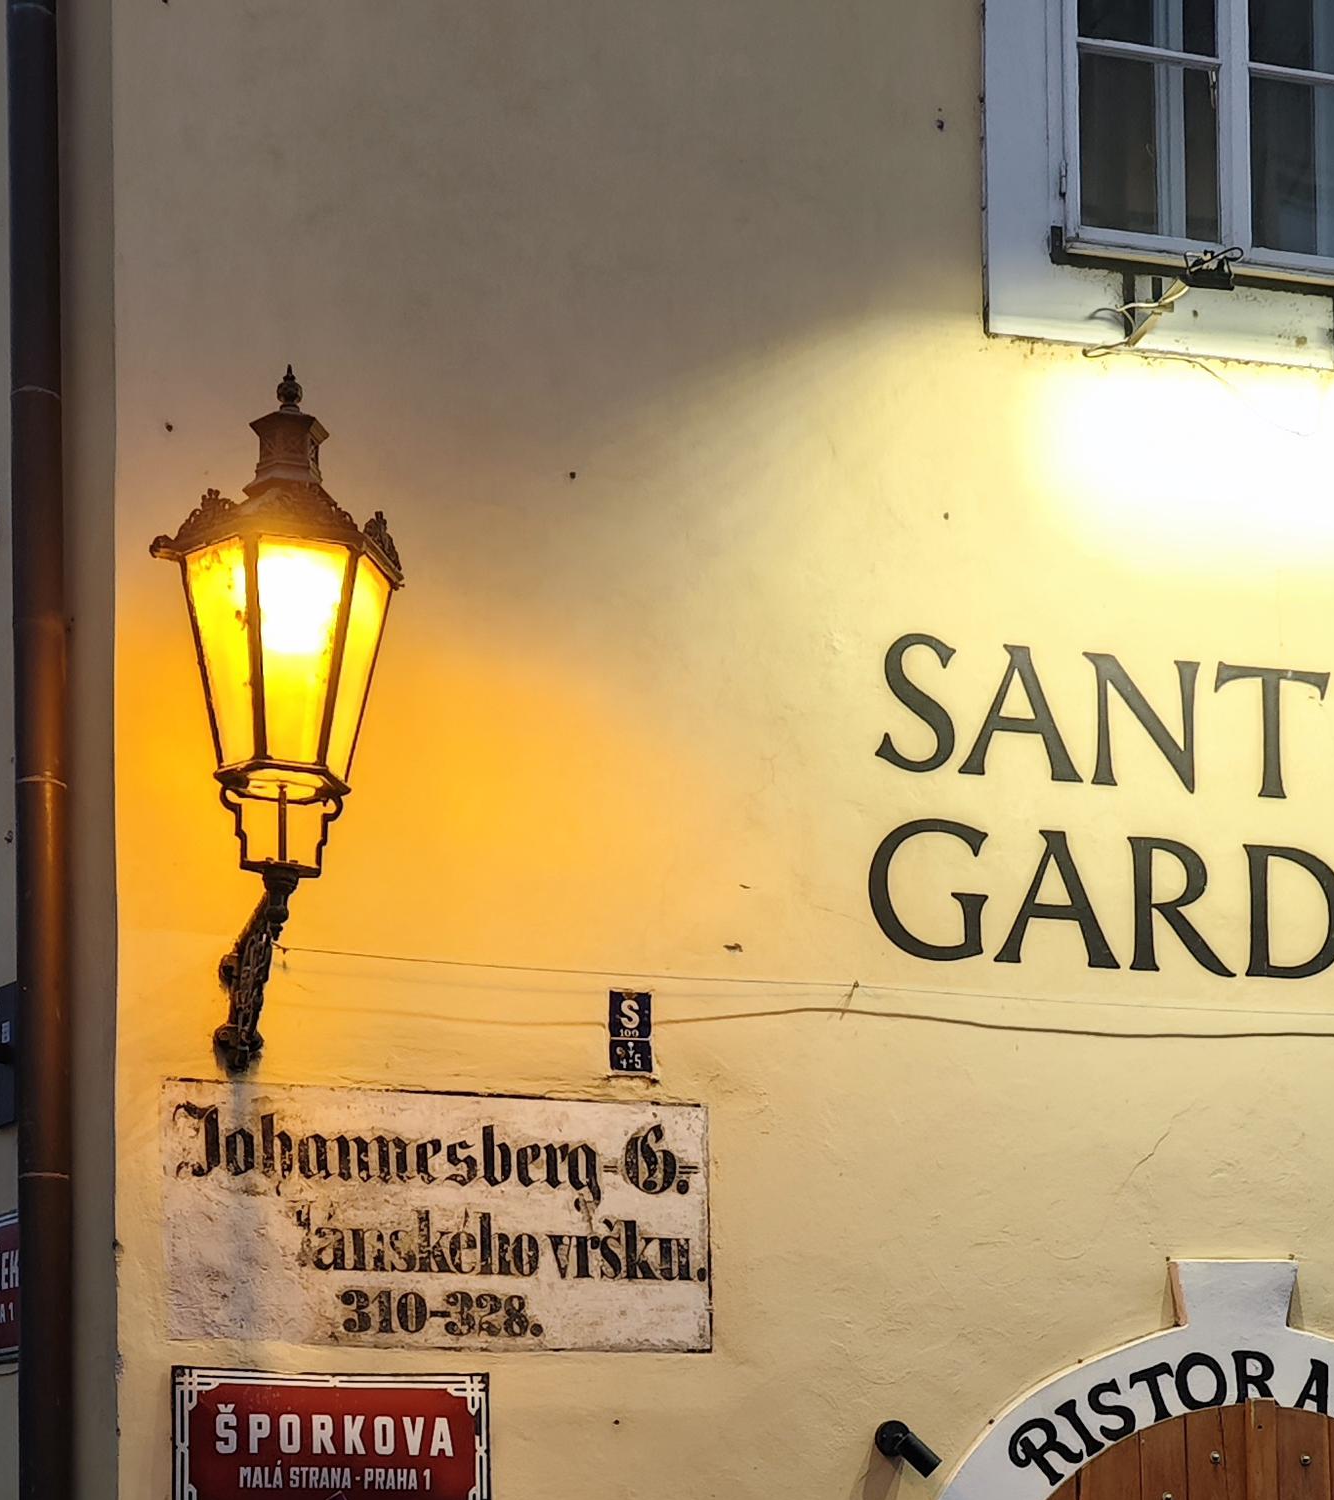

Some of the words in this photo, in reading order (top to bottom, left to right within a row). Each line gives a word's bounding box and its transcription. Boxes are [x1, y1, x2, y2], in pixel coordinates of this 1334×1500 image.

[620, 999, 640, 1029] S
[619, 1028, 640, 1037] 100
[8, 1302, 15, 1321] 1
[215, 1403, 455, 1457] ŠPORKOVA
[239, 1459, 284, 1489] MALÁ
[289, 1466, 352, 1489] STRANA
[363, 1467, 418, 1490] PRAHA
[423, 1468, 431, 1490] 1
